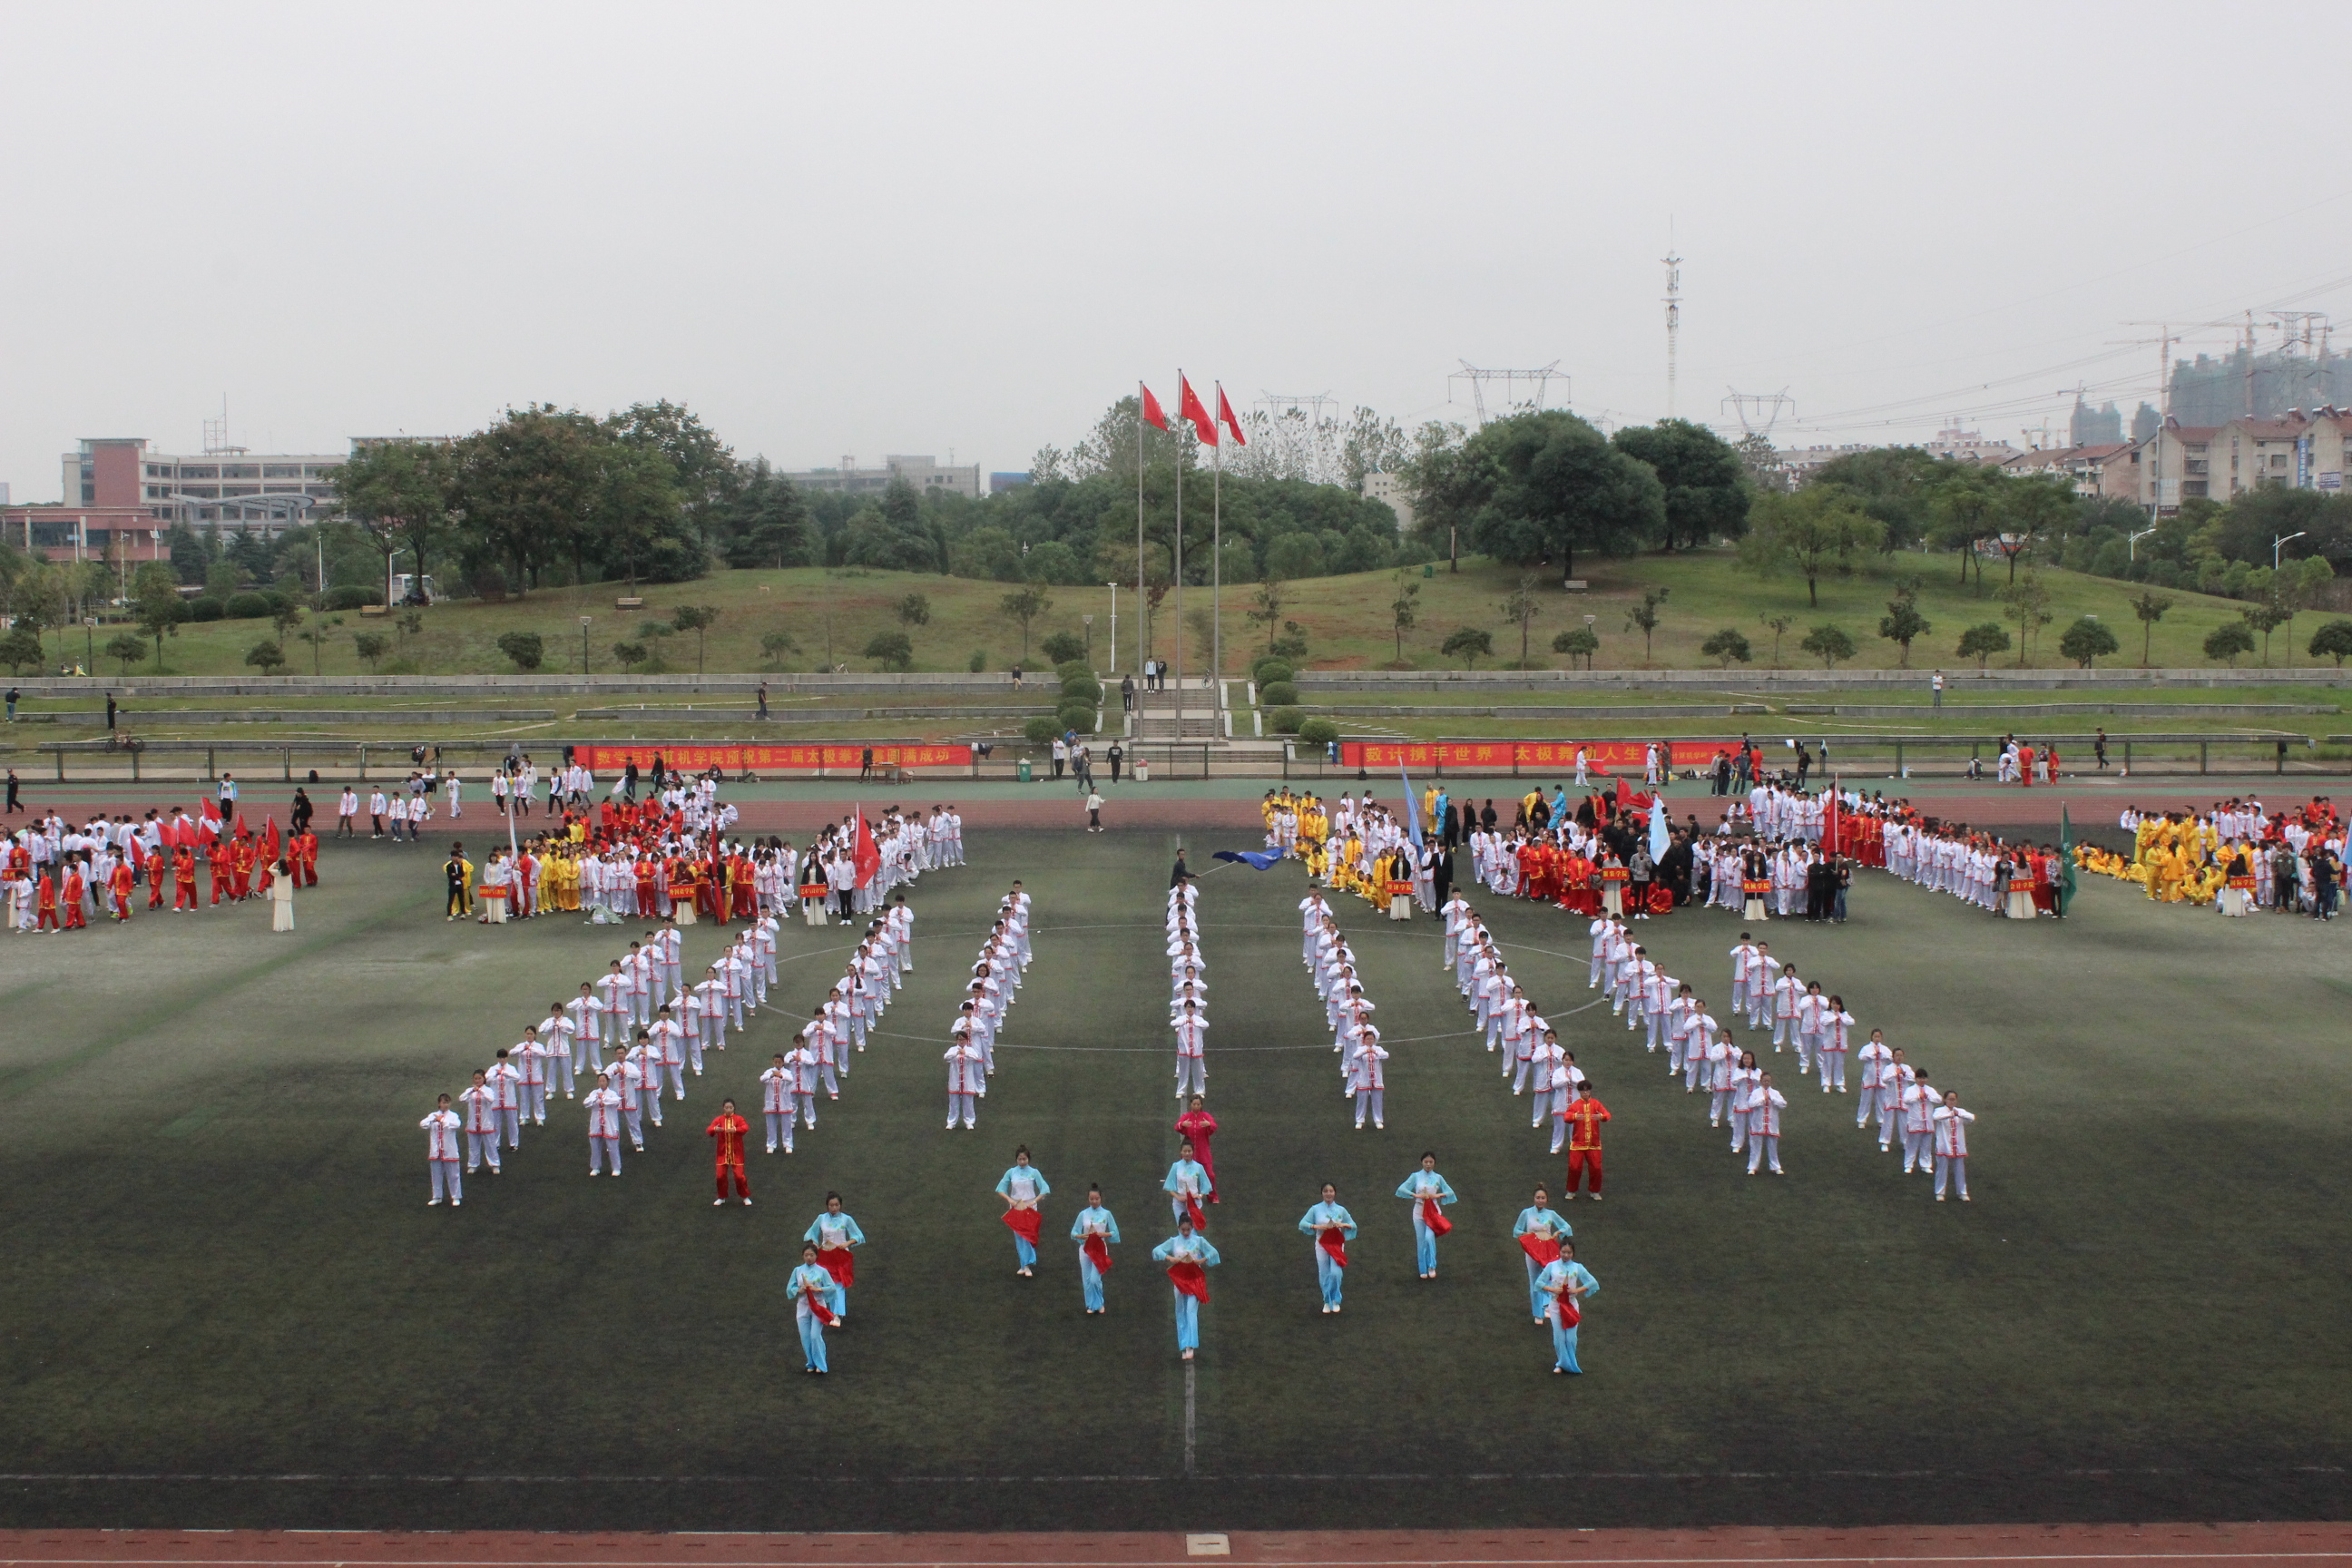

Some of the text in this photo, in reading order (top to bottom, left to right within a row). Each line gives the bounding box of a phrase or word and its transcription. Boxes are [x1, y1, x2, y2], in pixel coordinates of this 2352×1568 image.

[1366, 746, 1641, 762] 数计携手世界 太极舞动人生
